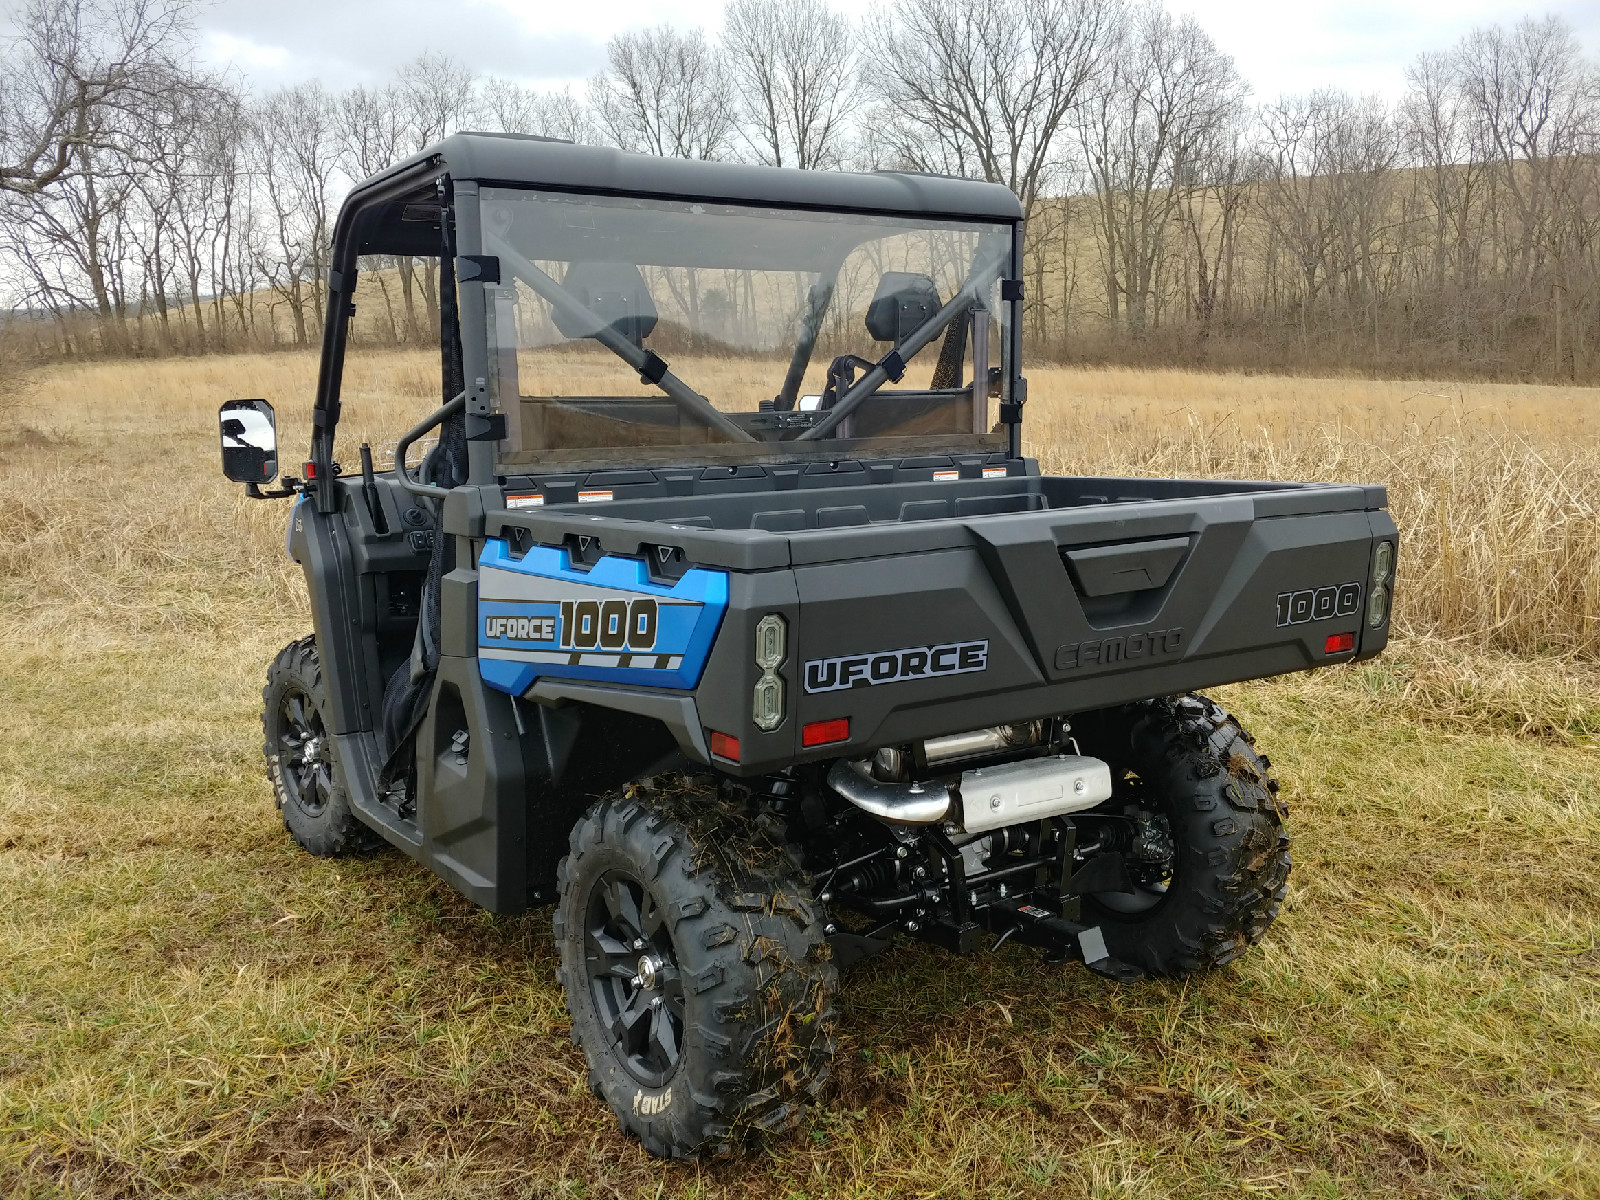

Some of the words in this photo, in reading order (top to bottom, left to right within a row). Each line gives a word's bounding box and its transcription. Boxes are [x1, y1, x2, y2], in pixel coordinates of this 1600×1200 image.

[486, 616, 555, 641] UFORCE
[559, 597, 658, 651] 1000
[1276, 582, 1361, 627] 1000
[804, 640, 988, 693] UFORCE
[1054, 627, 1184, 670] CFMOTO
